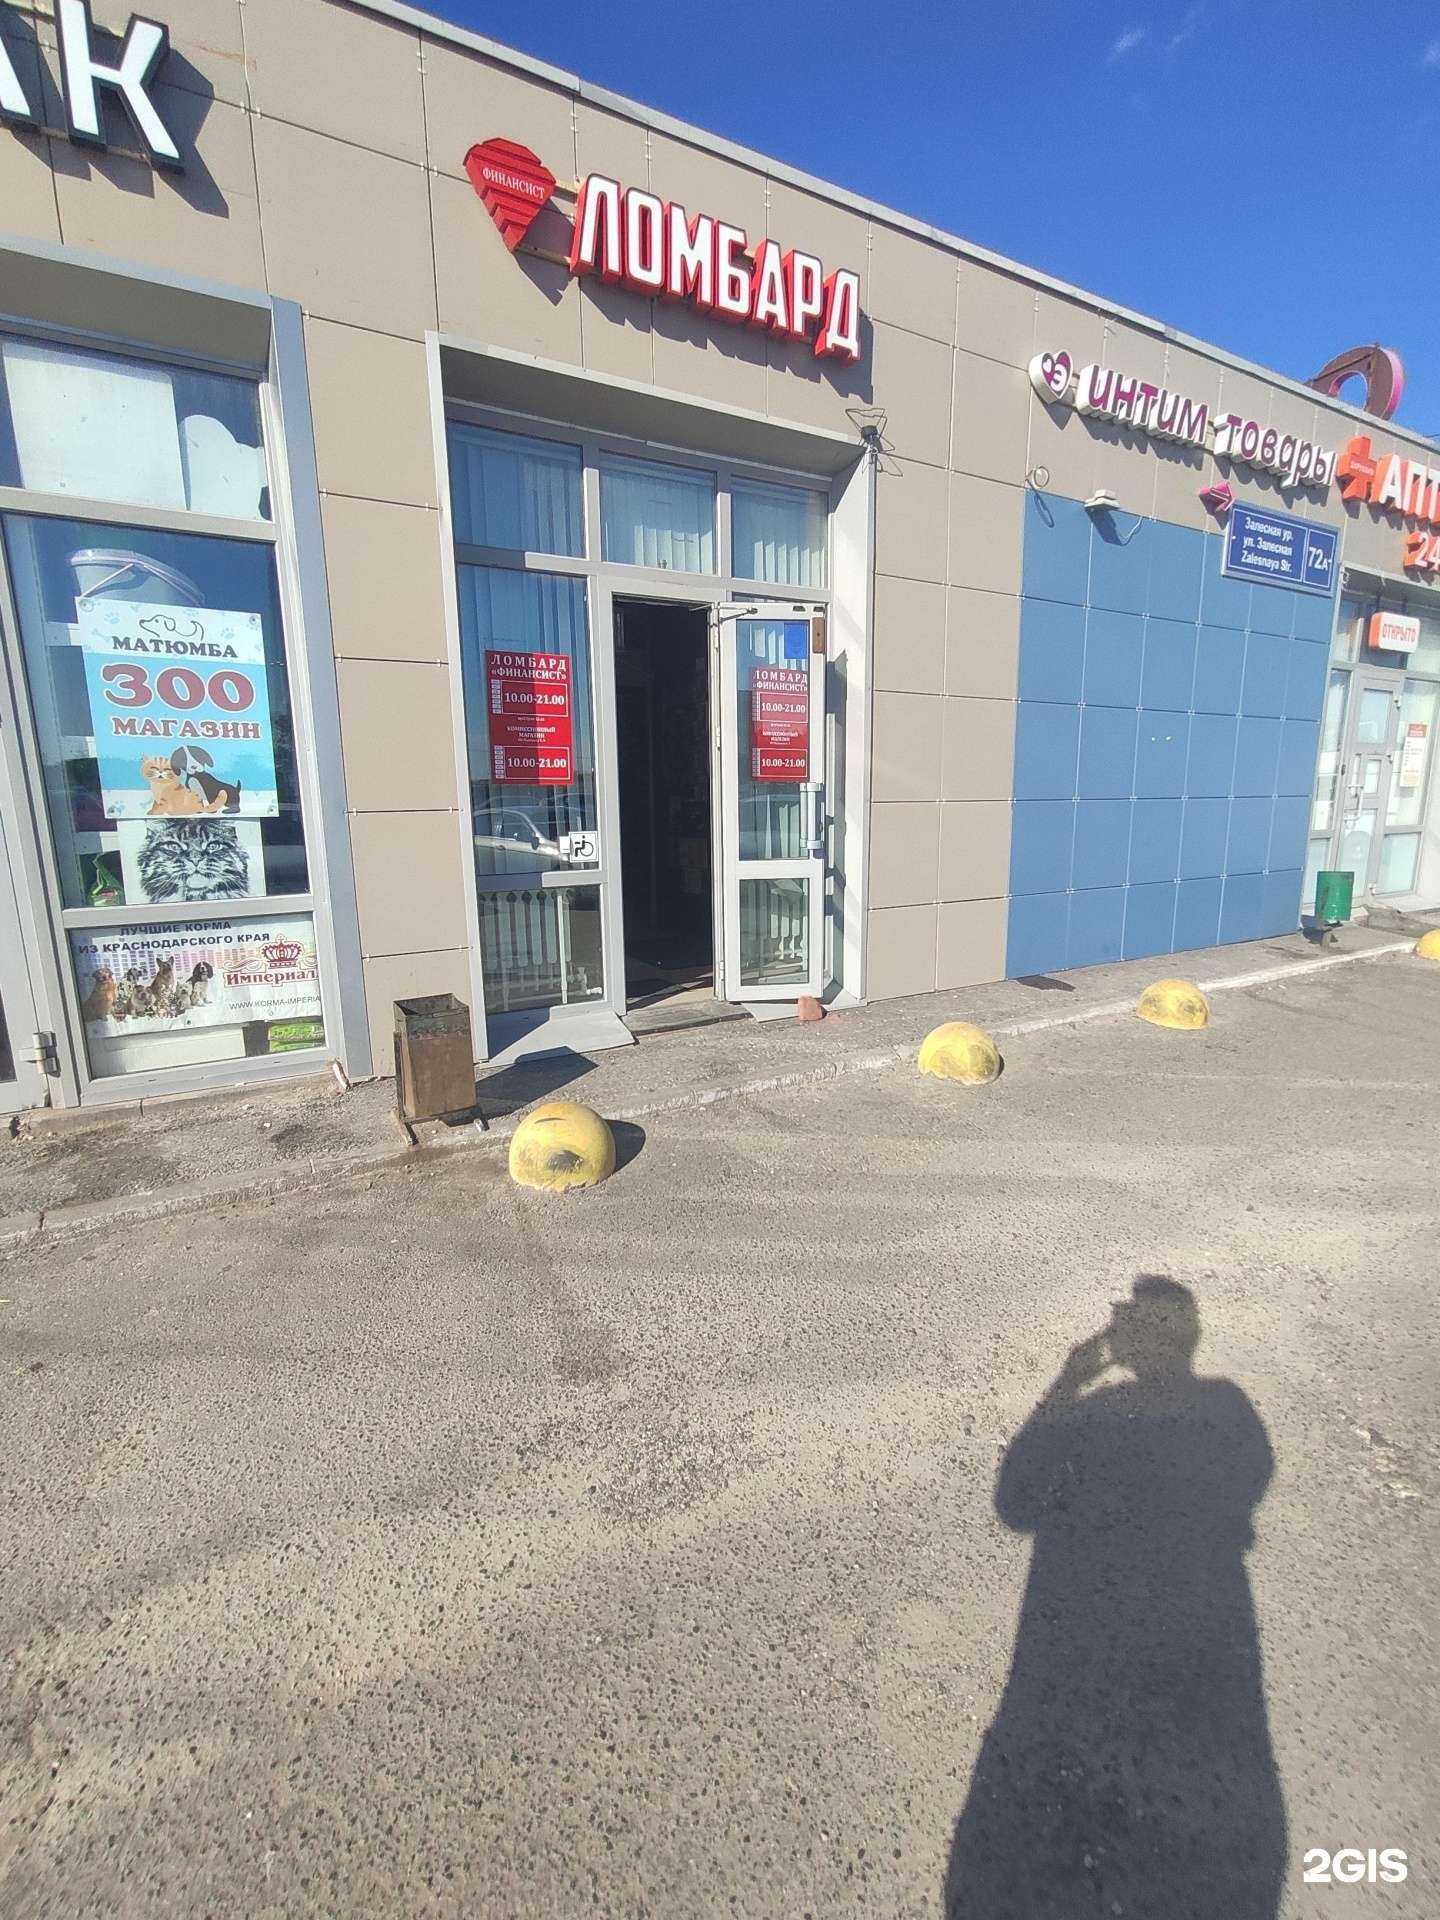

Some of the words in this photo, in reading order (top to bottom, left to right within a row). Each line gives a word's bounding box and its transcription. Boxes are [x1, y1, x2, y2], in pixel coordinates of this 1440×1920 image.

[482, 167, 545, 200] ФИНАНСИСТ
[571, 172, 861, 361] ЛОМБАРД
[1244, 517, 1281, 537] Залесная
[1243, 536, 1256, 548] ул.
[1257, 537, 1293, 556] Залесная
[1241, 551, 1280, 571] Zalesnaya
[1280, 559, 1293, 573] Str.
[112, 635, 238, 658] МАТЮМБА
[491, 655, 567, 672] ЛОМБАРД
[752, 670, 808, 685] ЛОМБАРД
[504, 692, 565, 705] 10.00-21.00
[761, 702, 806, 713] 10.00-21.00
[111, 716, 261, 739] МАГАЗИН
[507, 757, 567, 768] 10.00-21.00
[761, 758, 806, 768] 10.00-21.00
[120, 922, 181, 937] ЛУЧШИЕ
[185, 920, 232, 933] КОРМА
[79, 944, 98, 955] ИЗ
[102, 935, 233, 953] КРАСНОДАРСКОГО
[237, 933, 271, 943] КРАЯ
[226, 970, 319, 986] Империал
